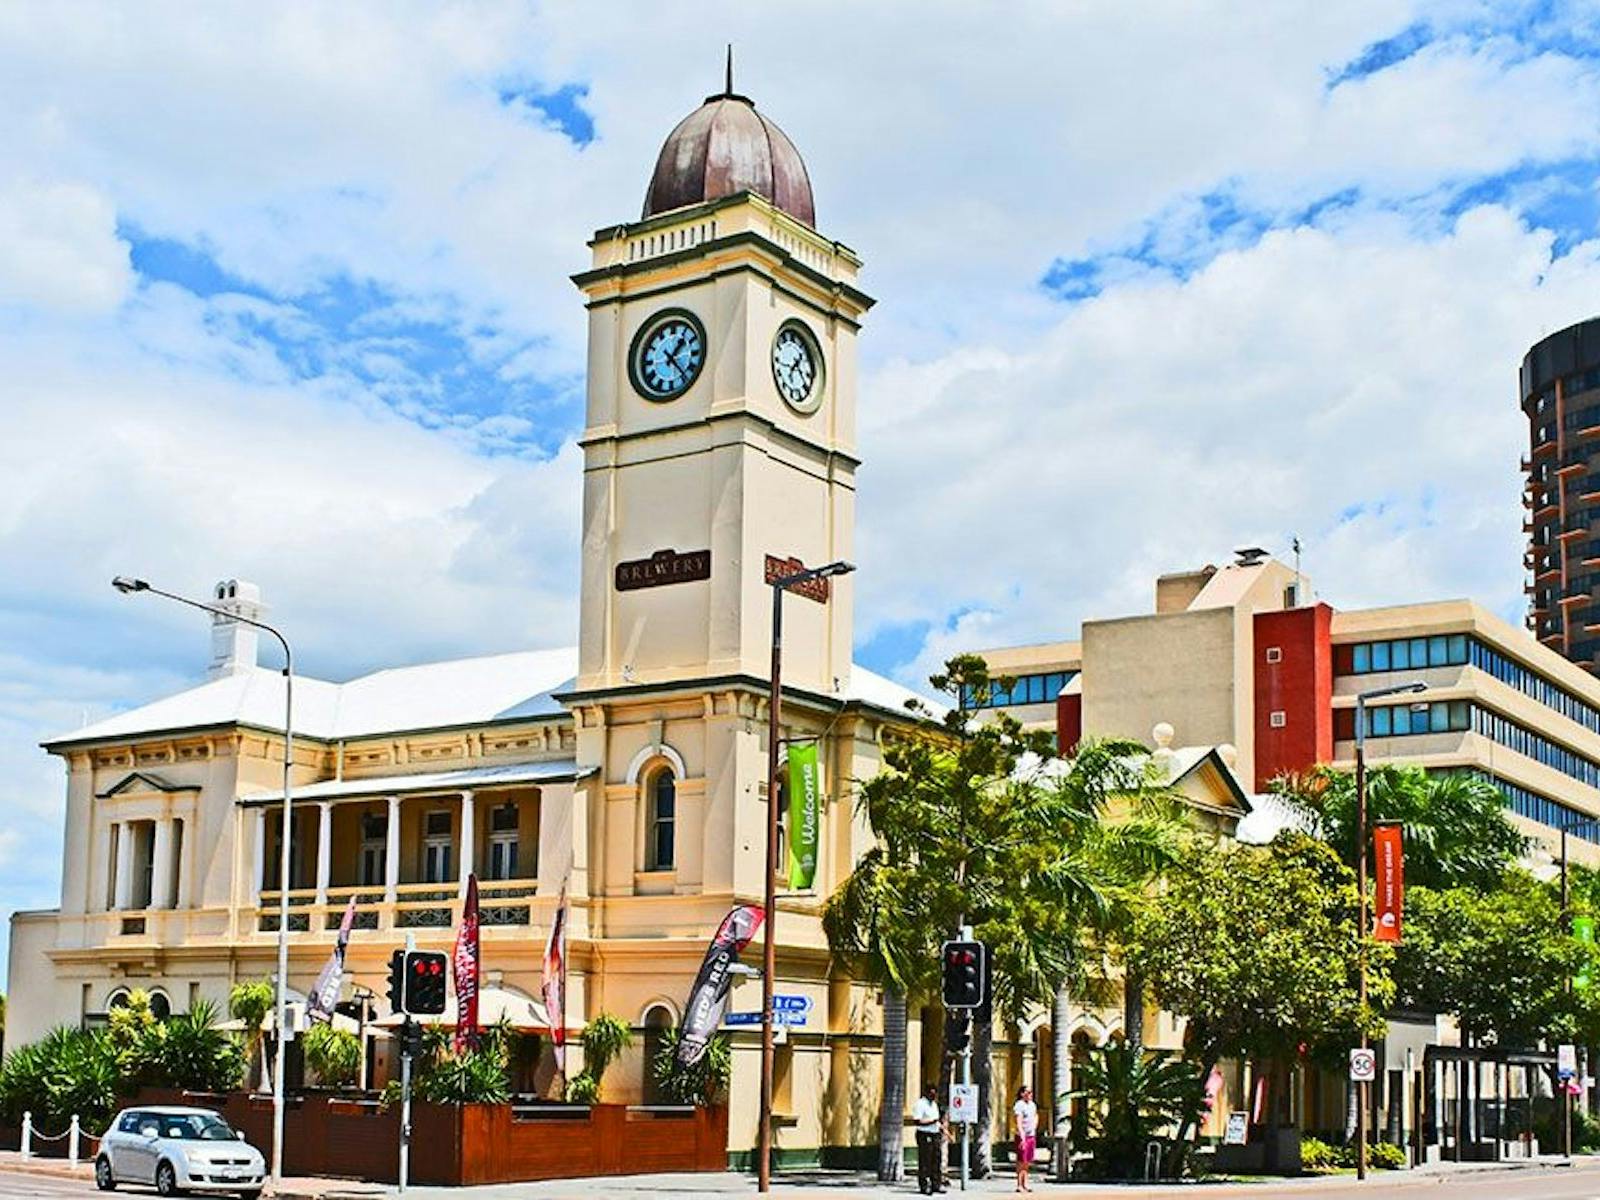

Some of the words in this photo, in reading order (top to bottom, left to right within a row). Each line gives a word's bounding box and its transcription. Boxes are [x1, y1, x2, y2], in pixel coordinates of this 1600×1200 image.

[619, 556, 705, 581] BREWERY
[802, 764, 816, 845] Welcome
[709, 951, 730, 983] RED
